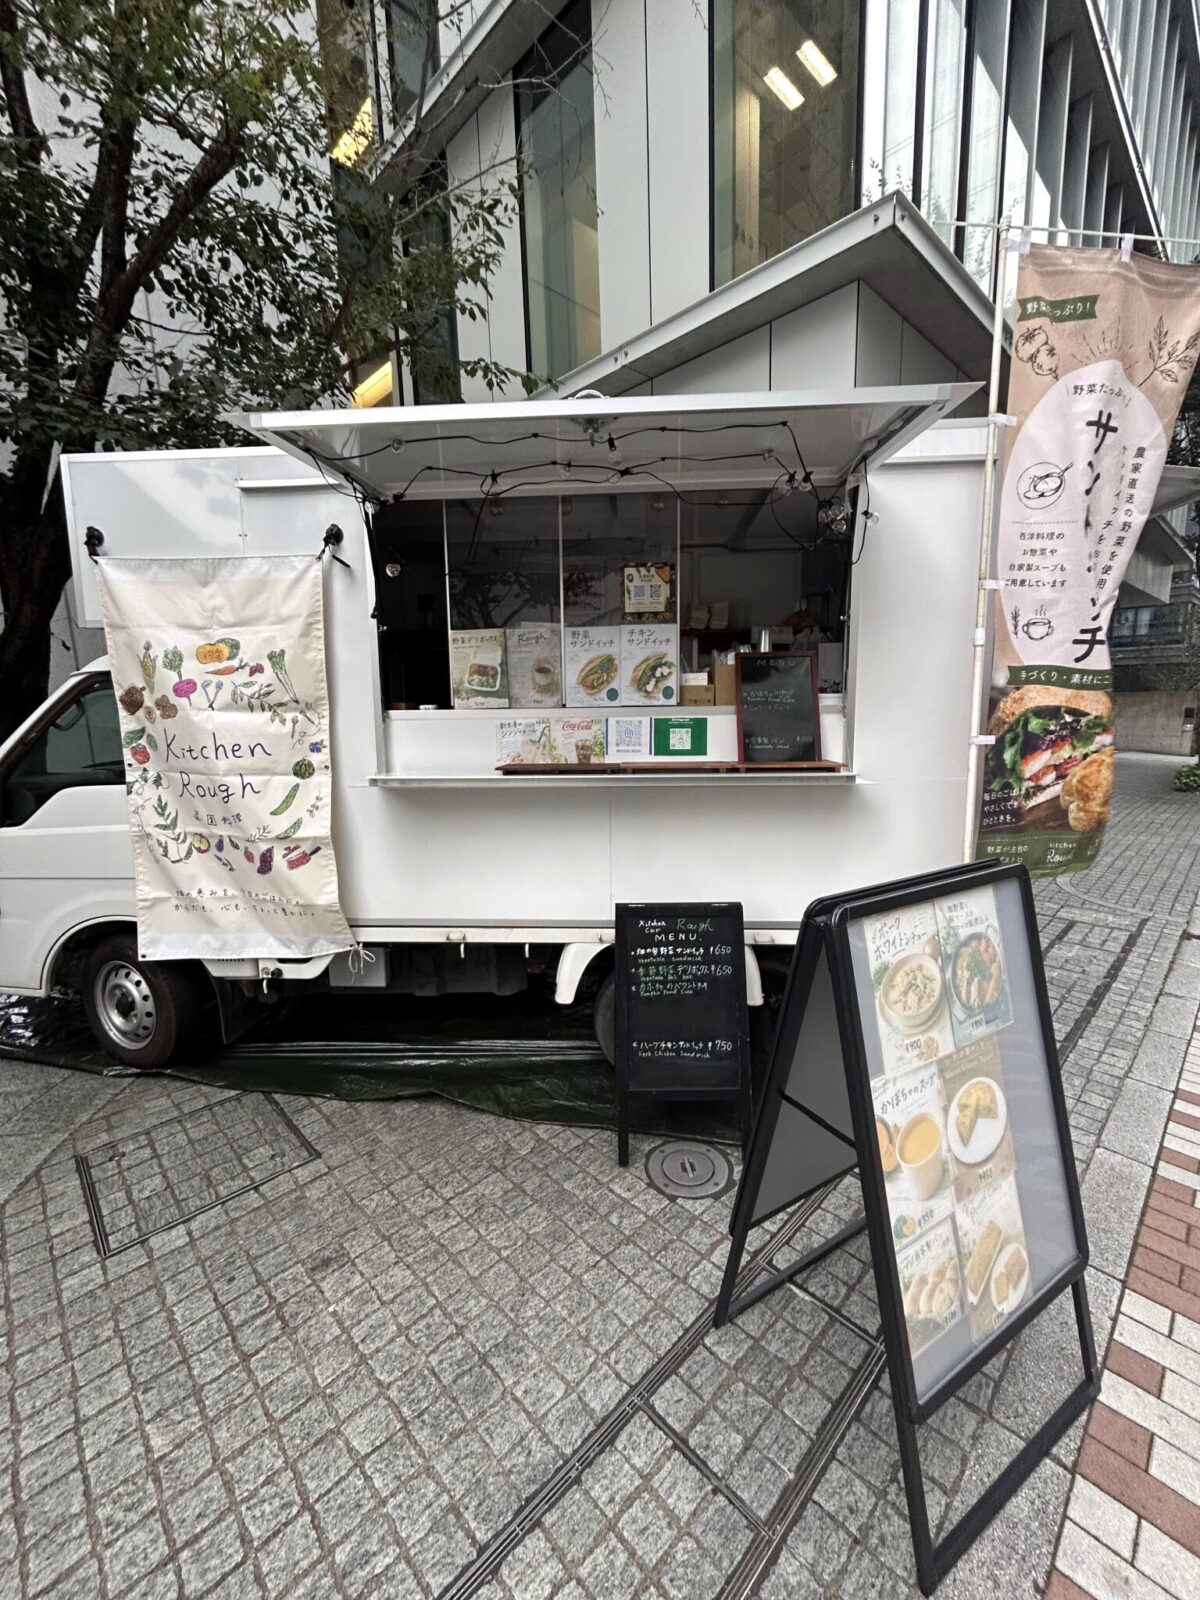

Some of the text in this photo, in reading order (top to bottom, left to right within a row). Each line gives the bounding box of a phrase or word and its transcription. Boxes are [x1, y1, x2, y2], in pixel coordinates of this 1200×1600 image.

[1096, 446, 1146, 590] 農家直送の野菜を使用
[1072, 409, 1118, 664] サンッチ
[1009, 563, 1066, 572] 自家製スープも
[571, 630, 590, 640] 野菜
[628, 628, 656, 637] チキン
[570, 640, 616, 648] サンドイッチ
[627, 637, 672, 646] サンドイッチ
[164, 728, 272, 763] Kitchen
[179, 770, 261, 804] Rough
